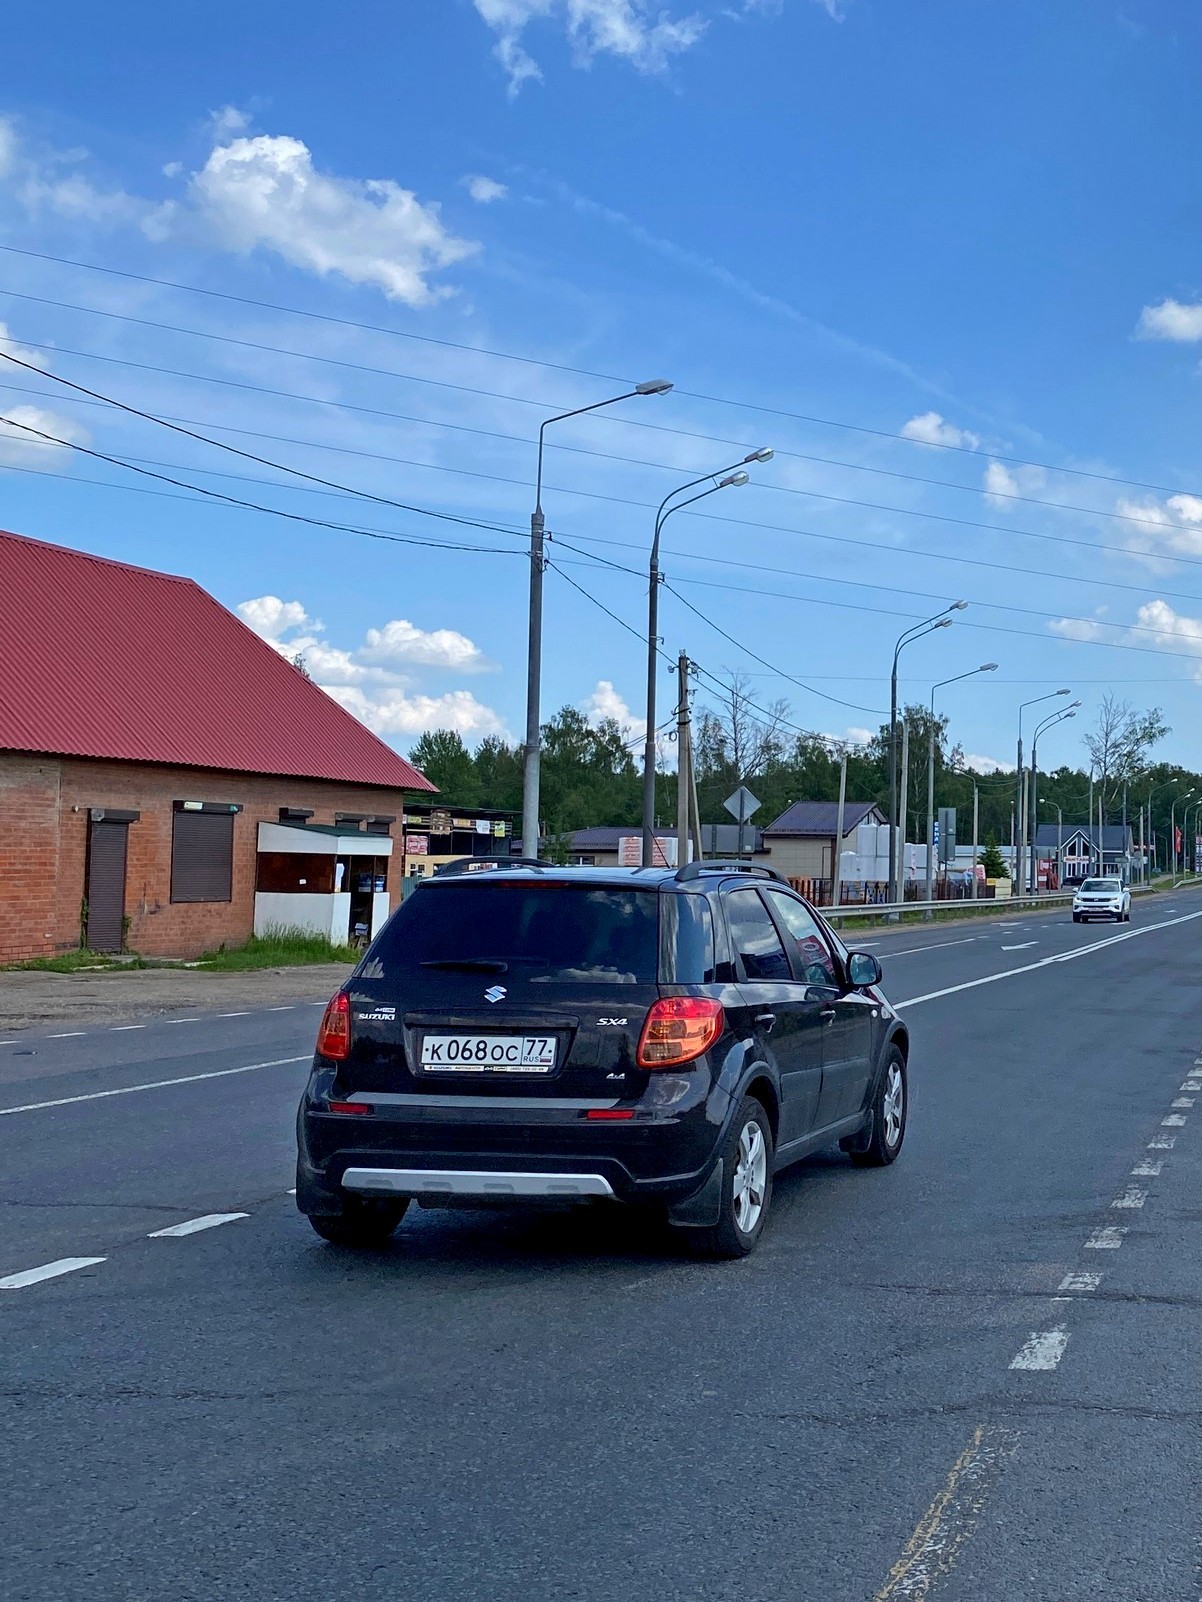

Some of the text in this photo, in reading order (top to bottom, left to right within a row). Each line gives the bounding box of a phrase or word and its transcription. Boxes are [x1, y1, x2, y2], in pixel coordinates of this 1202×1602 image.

[358, 1013, 396, 1021] SUZUKI
[596, 1018, 628, 1026] SX4
[526, 1039, 548, 1056] 77
